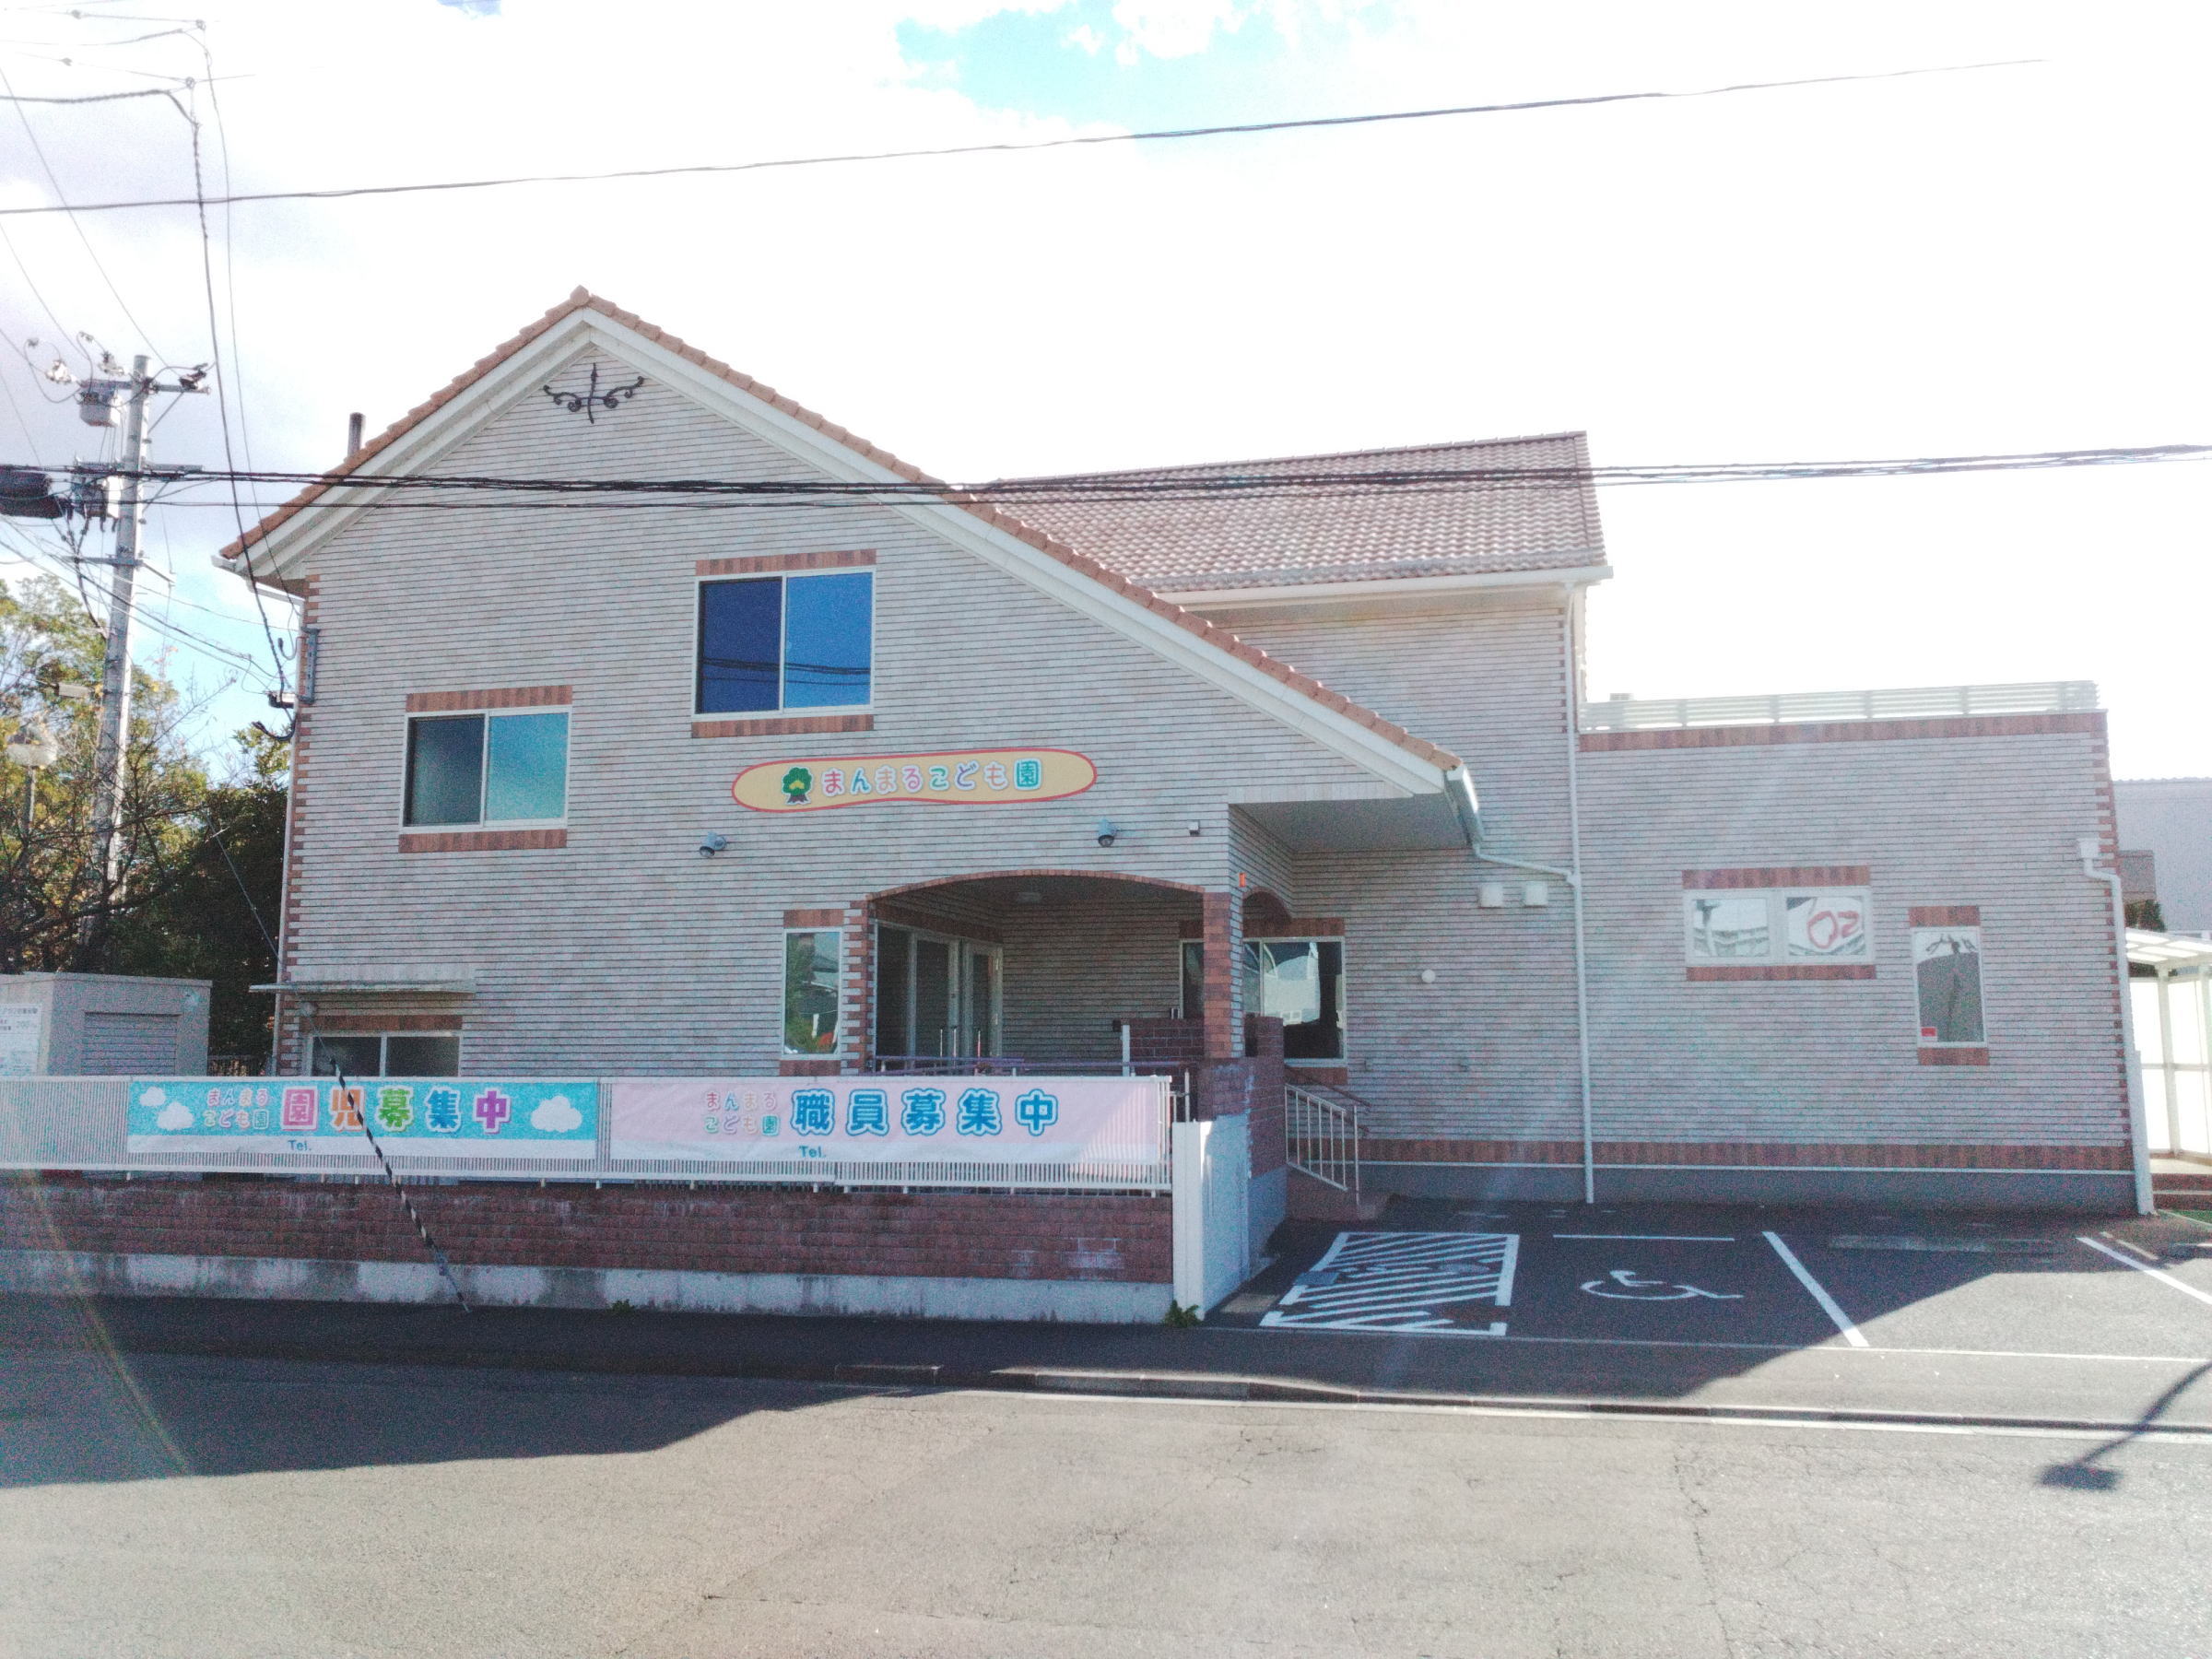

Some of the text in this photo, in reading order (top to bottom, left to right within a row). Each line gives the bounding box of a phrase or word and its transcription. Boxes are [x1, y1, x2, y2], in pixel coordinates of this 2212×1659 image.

[821, 759, 1042, 796] まんまるこども園
[206, 1088, 268, 1107] まんまる
[706, 1091, 778, 1112] まんまる
[203, 1109, 269, 1130] こども園
[280, 1086, 511, 1134] 園児募集中
[790, 1088, 1058, 1136] 職員募集中
[703, 1114, 780, 1136] こども園
[798, 1145, 827, 1159] Tel.
